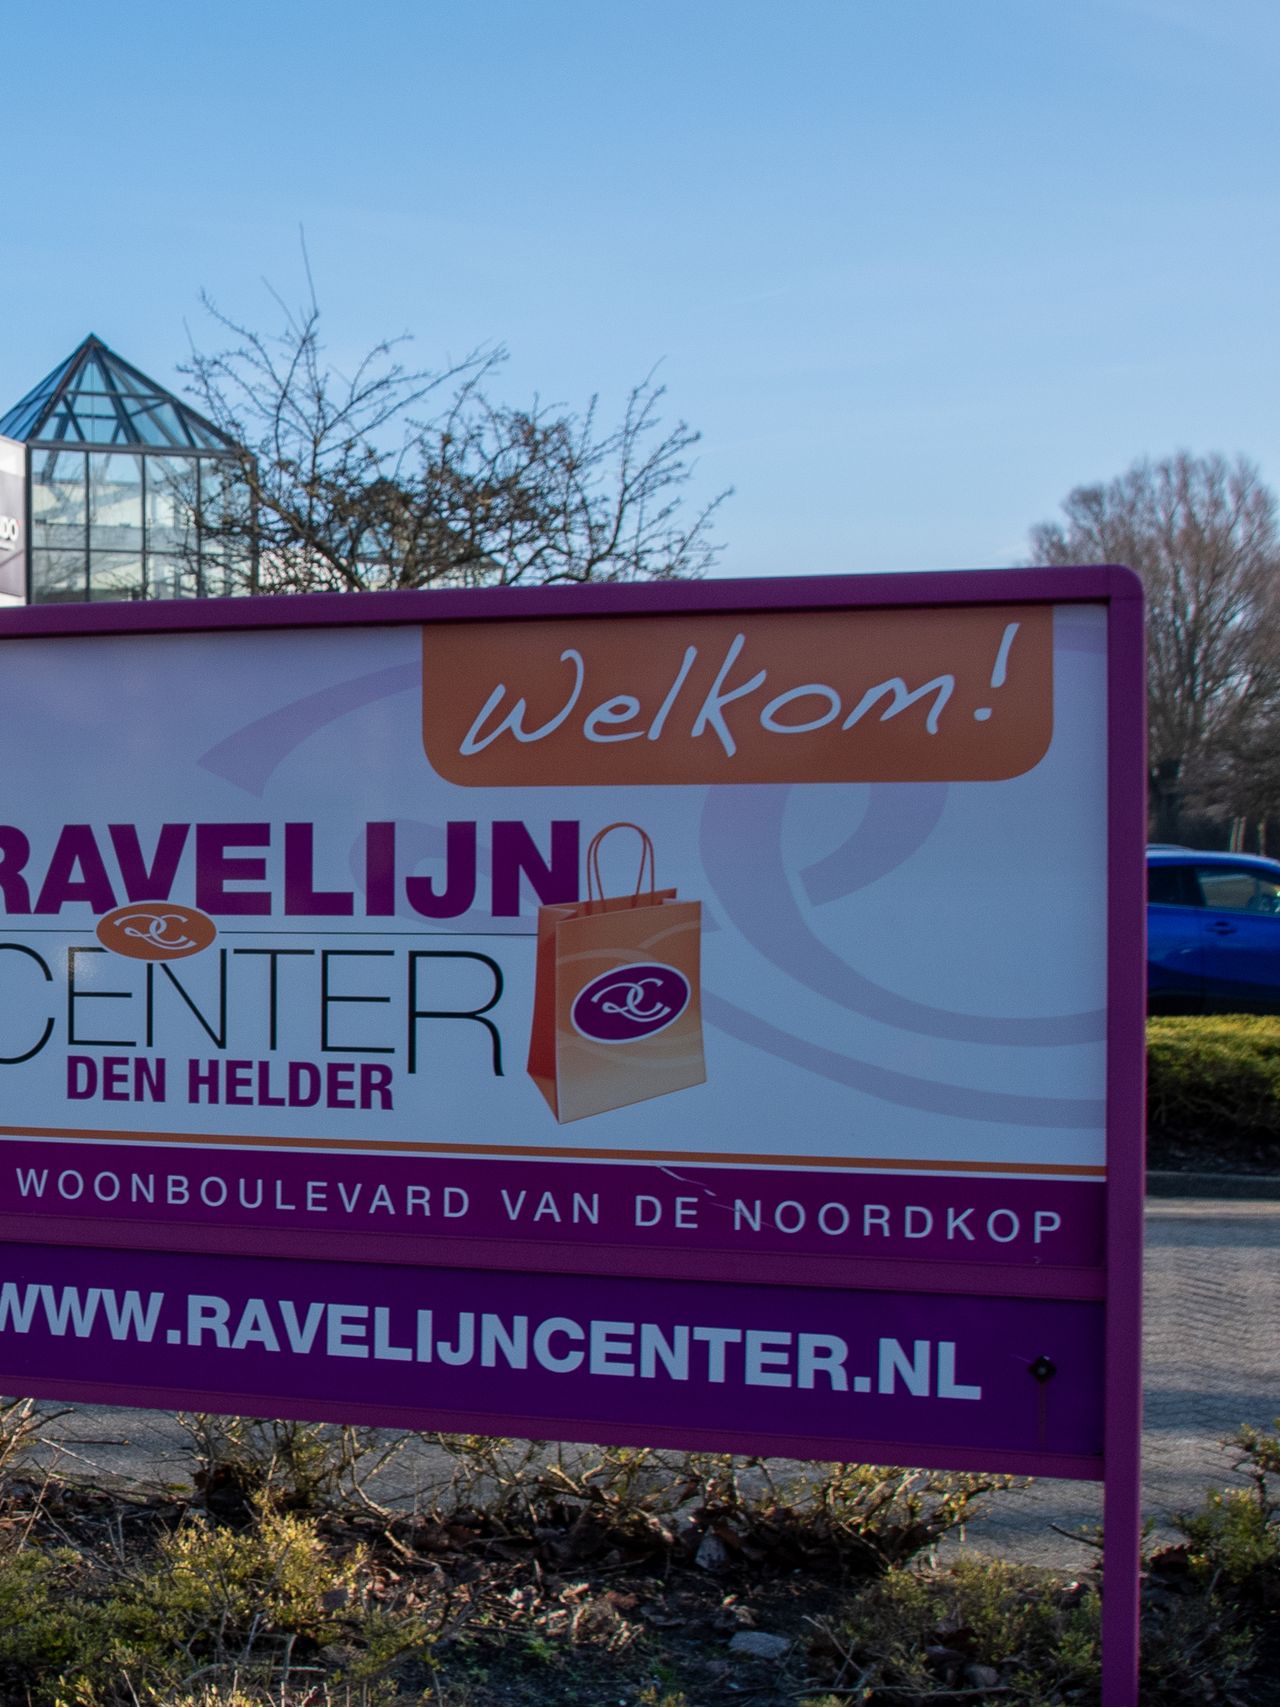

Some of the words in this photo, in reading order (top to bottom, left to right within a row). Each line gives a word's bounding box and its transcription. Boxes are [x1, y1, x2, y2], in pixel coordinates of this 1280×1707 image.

[459, 623, 1022, 758] Welkom!
[66, 1055, 167, 1103] DEN
[188, 1059, 394, 1111] HELDER
[16, 1166, 472, 1220] WOONBOULEVARD
[500, 1188, 601, 1226] VAN
[634, 1194, 701, 1230] DE
[733, 1197, 1064, 1245] NOORDKOP
